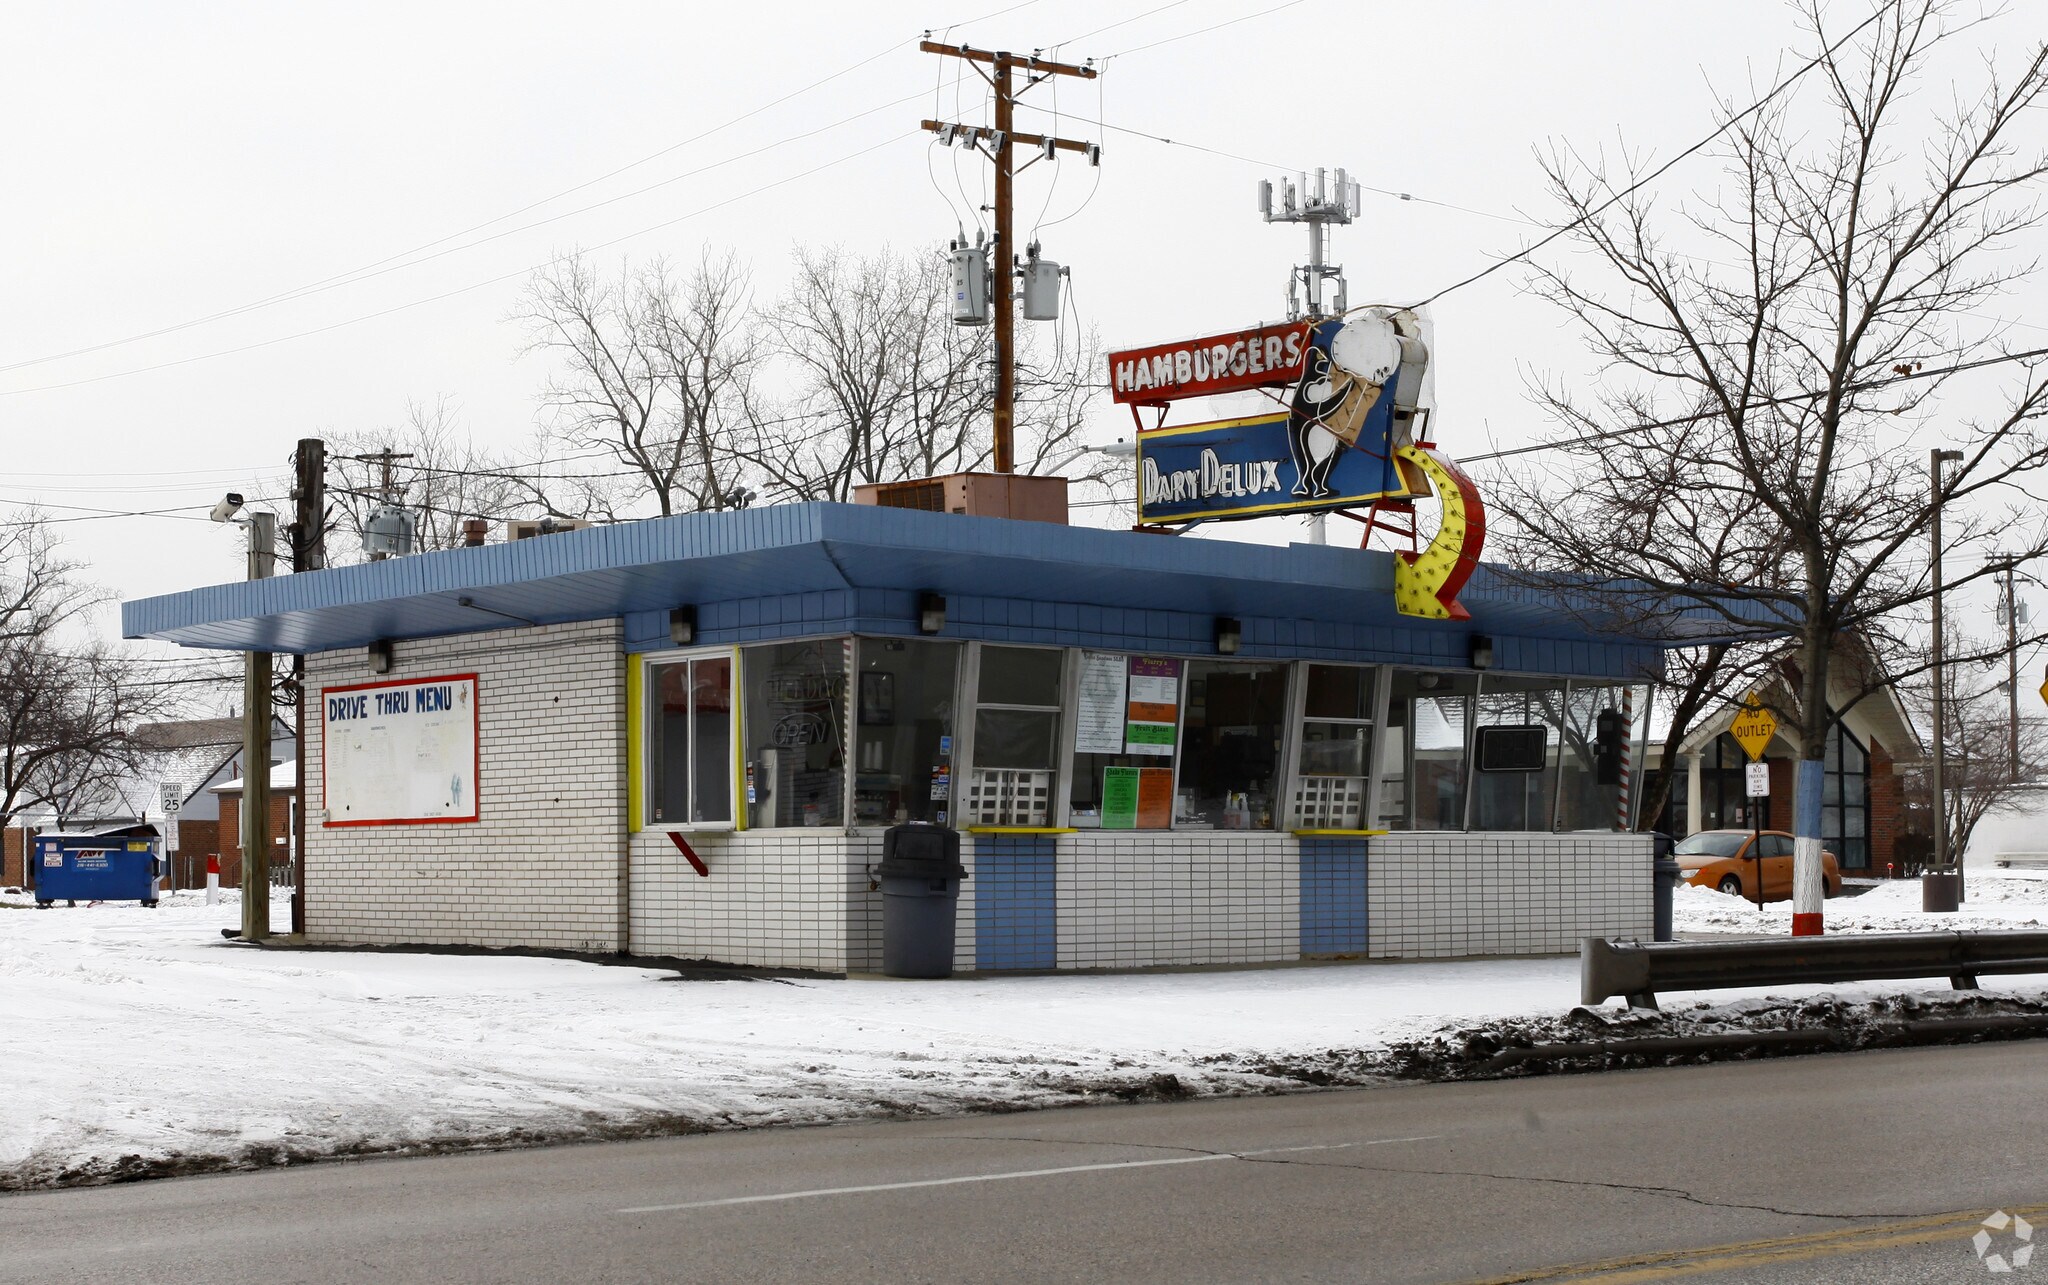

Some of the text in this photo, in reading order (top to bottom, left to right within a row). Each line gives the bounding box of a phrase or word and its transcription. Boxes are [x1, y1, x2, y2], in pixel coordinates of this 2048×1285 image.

[1116, 331, 1302, 393] HAMBURGERS
[1200, 447, 1282, 498] DELUX
[329, 685, 452, 722] DRIVE THRU MENU
[772, 721, 829, 745] OPEN
[1736, 724, 1772, 738] OUTLET
[164, 799, 180, 811] 25
